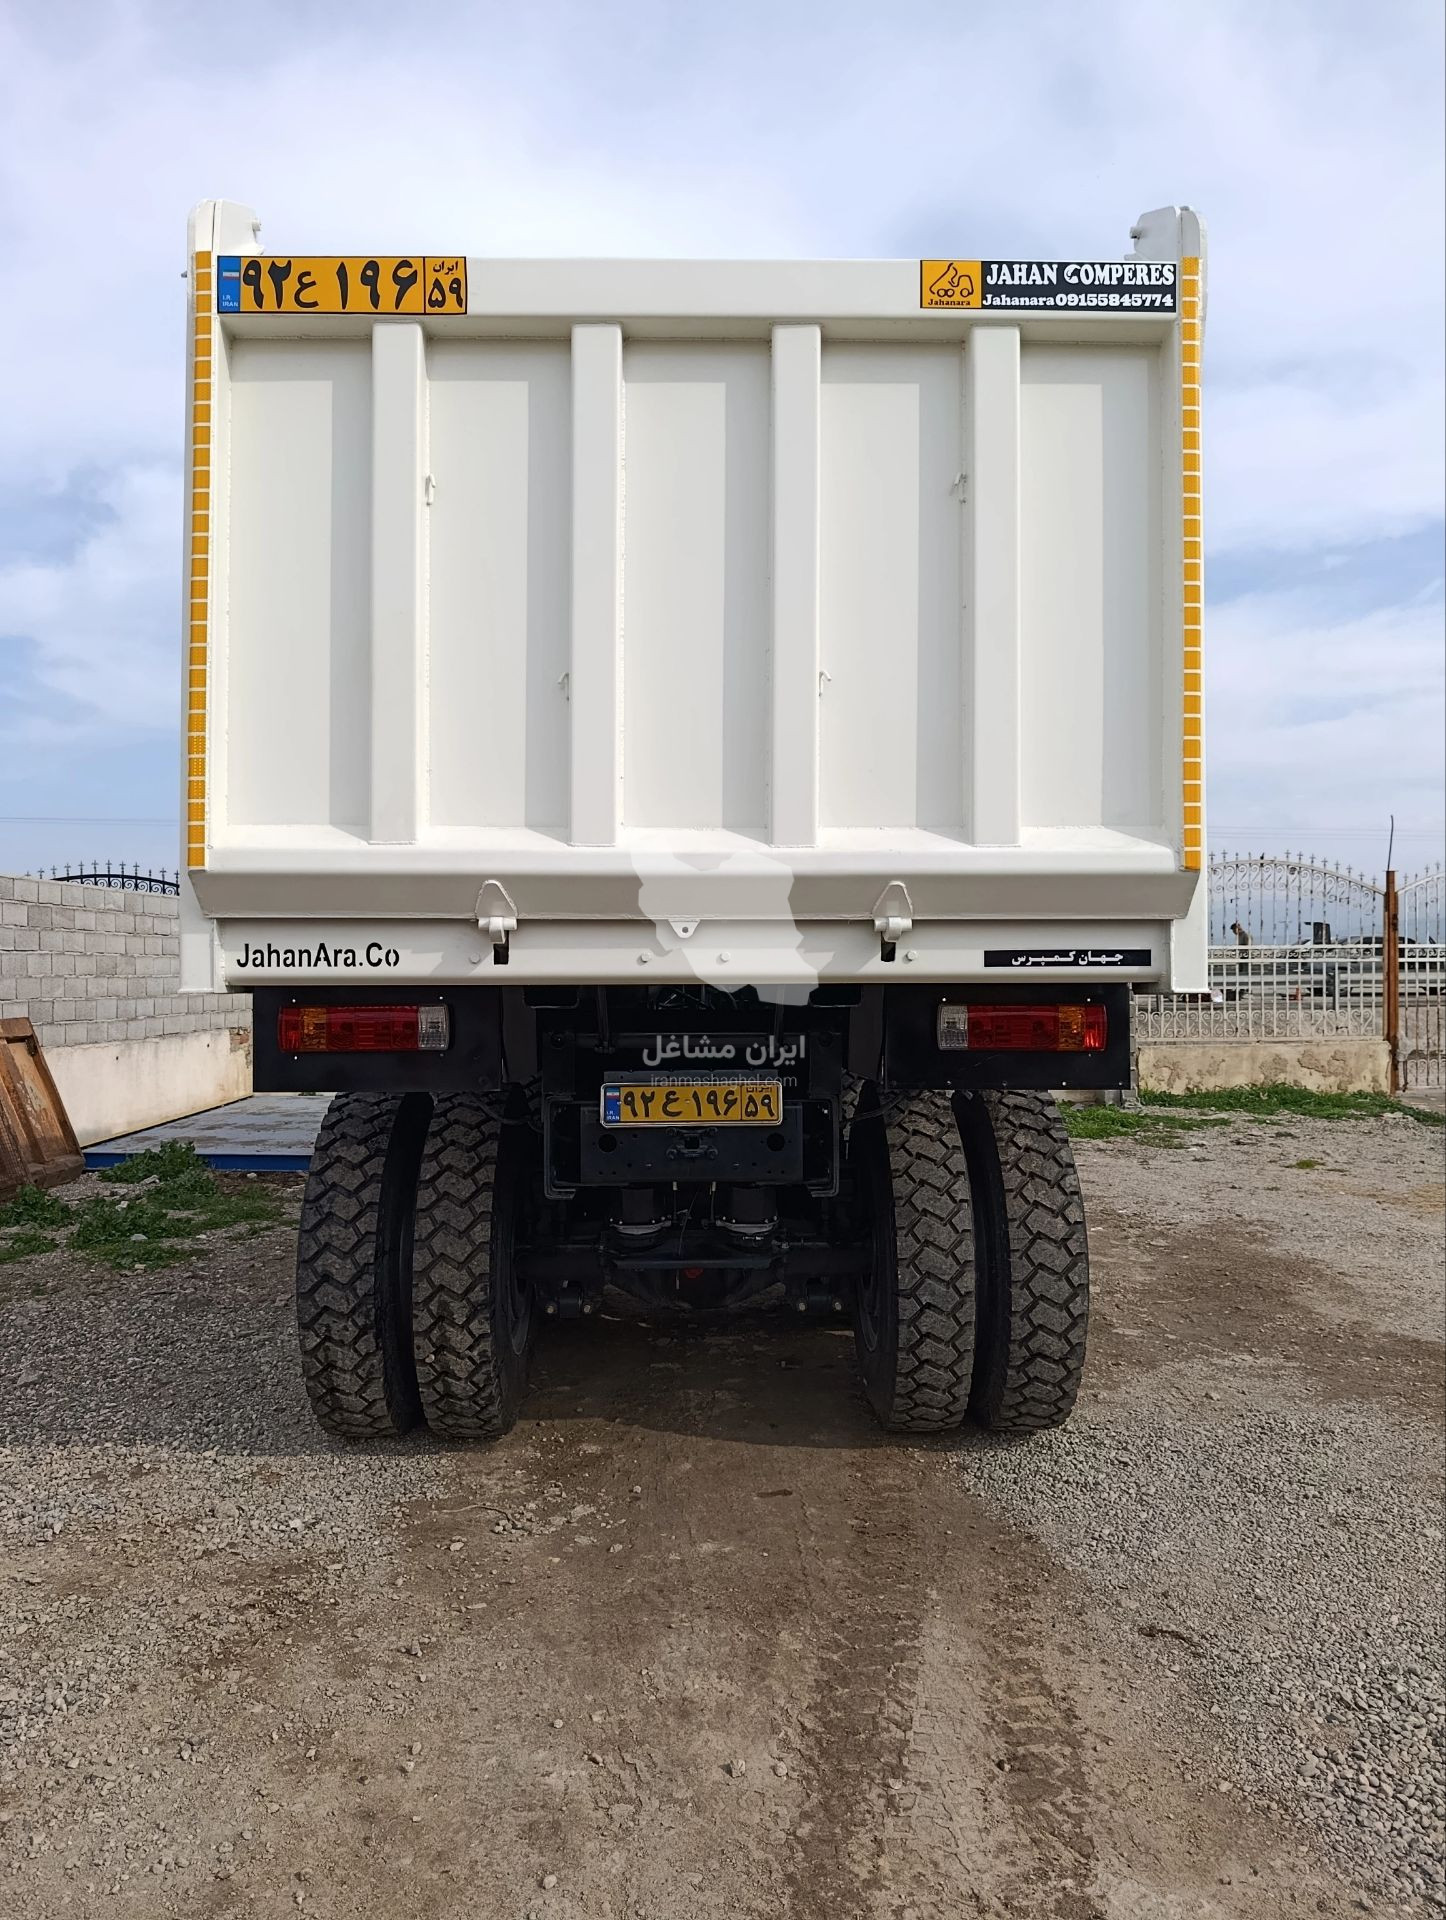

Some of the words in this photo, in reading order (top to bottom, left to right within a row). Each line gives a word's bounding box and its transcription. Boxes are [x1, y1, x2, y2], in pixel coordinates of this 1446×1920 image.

[432, 260, 459, 275] ایران
[986, 263, 1058, 285] JAHAN
[427, 277, 464, 309] ۵۹
[927, 298, 971, 306] Jahanara
[236, 941, 400, 968] JahanAra.Co
[1078, 950, 1124, 966] جهان
[744, 1094, 775, 1118] ۵۹
